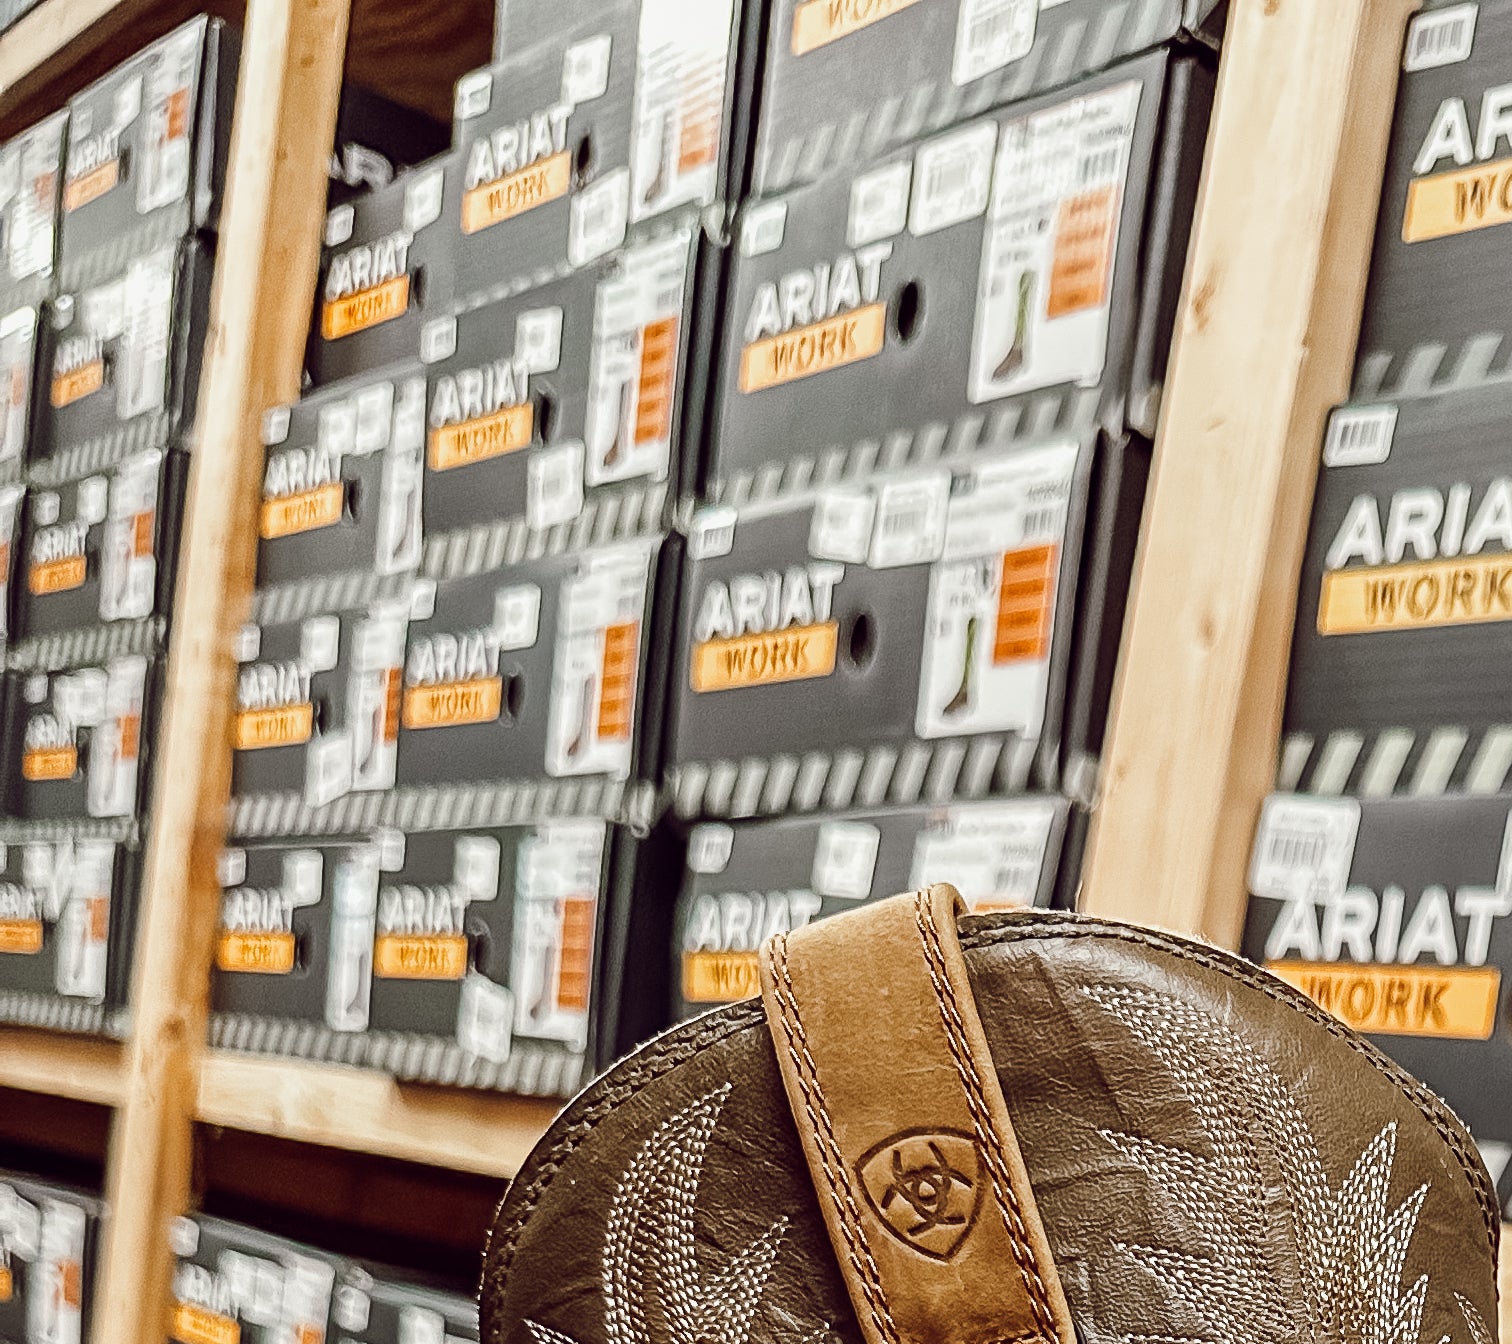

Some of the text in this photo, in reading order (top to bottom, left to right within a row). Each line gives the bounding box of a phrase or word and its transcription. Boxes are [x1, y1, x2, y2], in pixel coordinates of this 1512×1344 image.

[464, 102, 575, 190] ARIAT
[745, 241, 893, 343] ARIAT
[773, 320, 857, 375] WORK
[431, 355, 530, 428] ARIAT
[695, 562, 846, 643] ARIAT
[406, 627, 501, 687] ARIAT
[724, 637, 809, 680] WORK
[1303, 975, 1450, 1029] WORK
